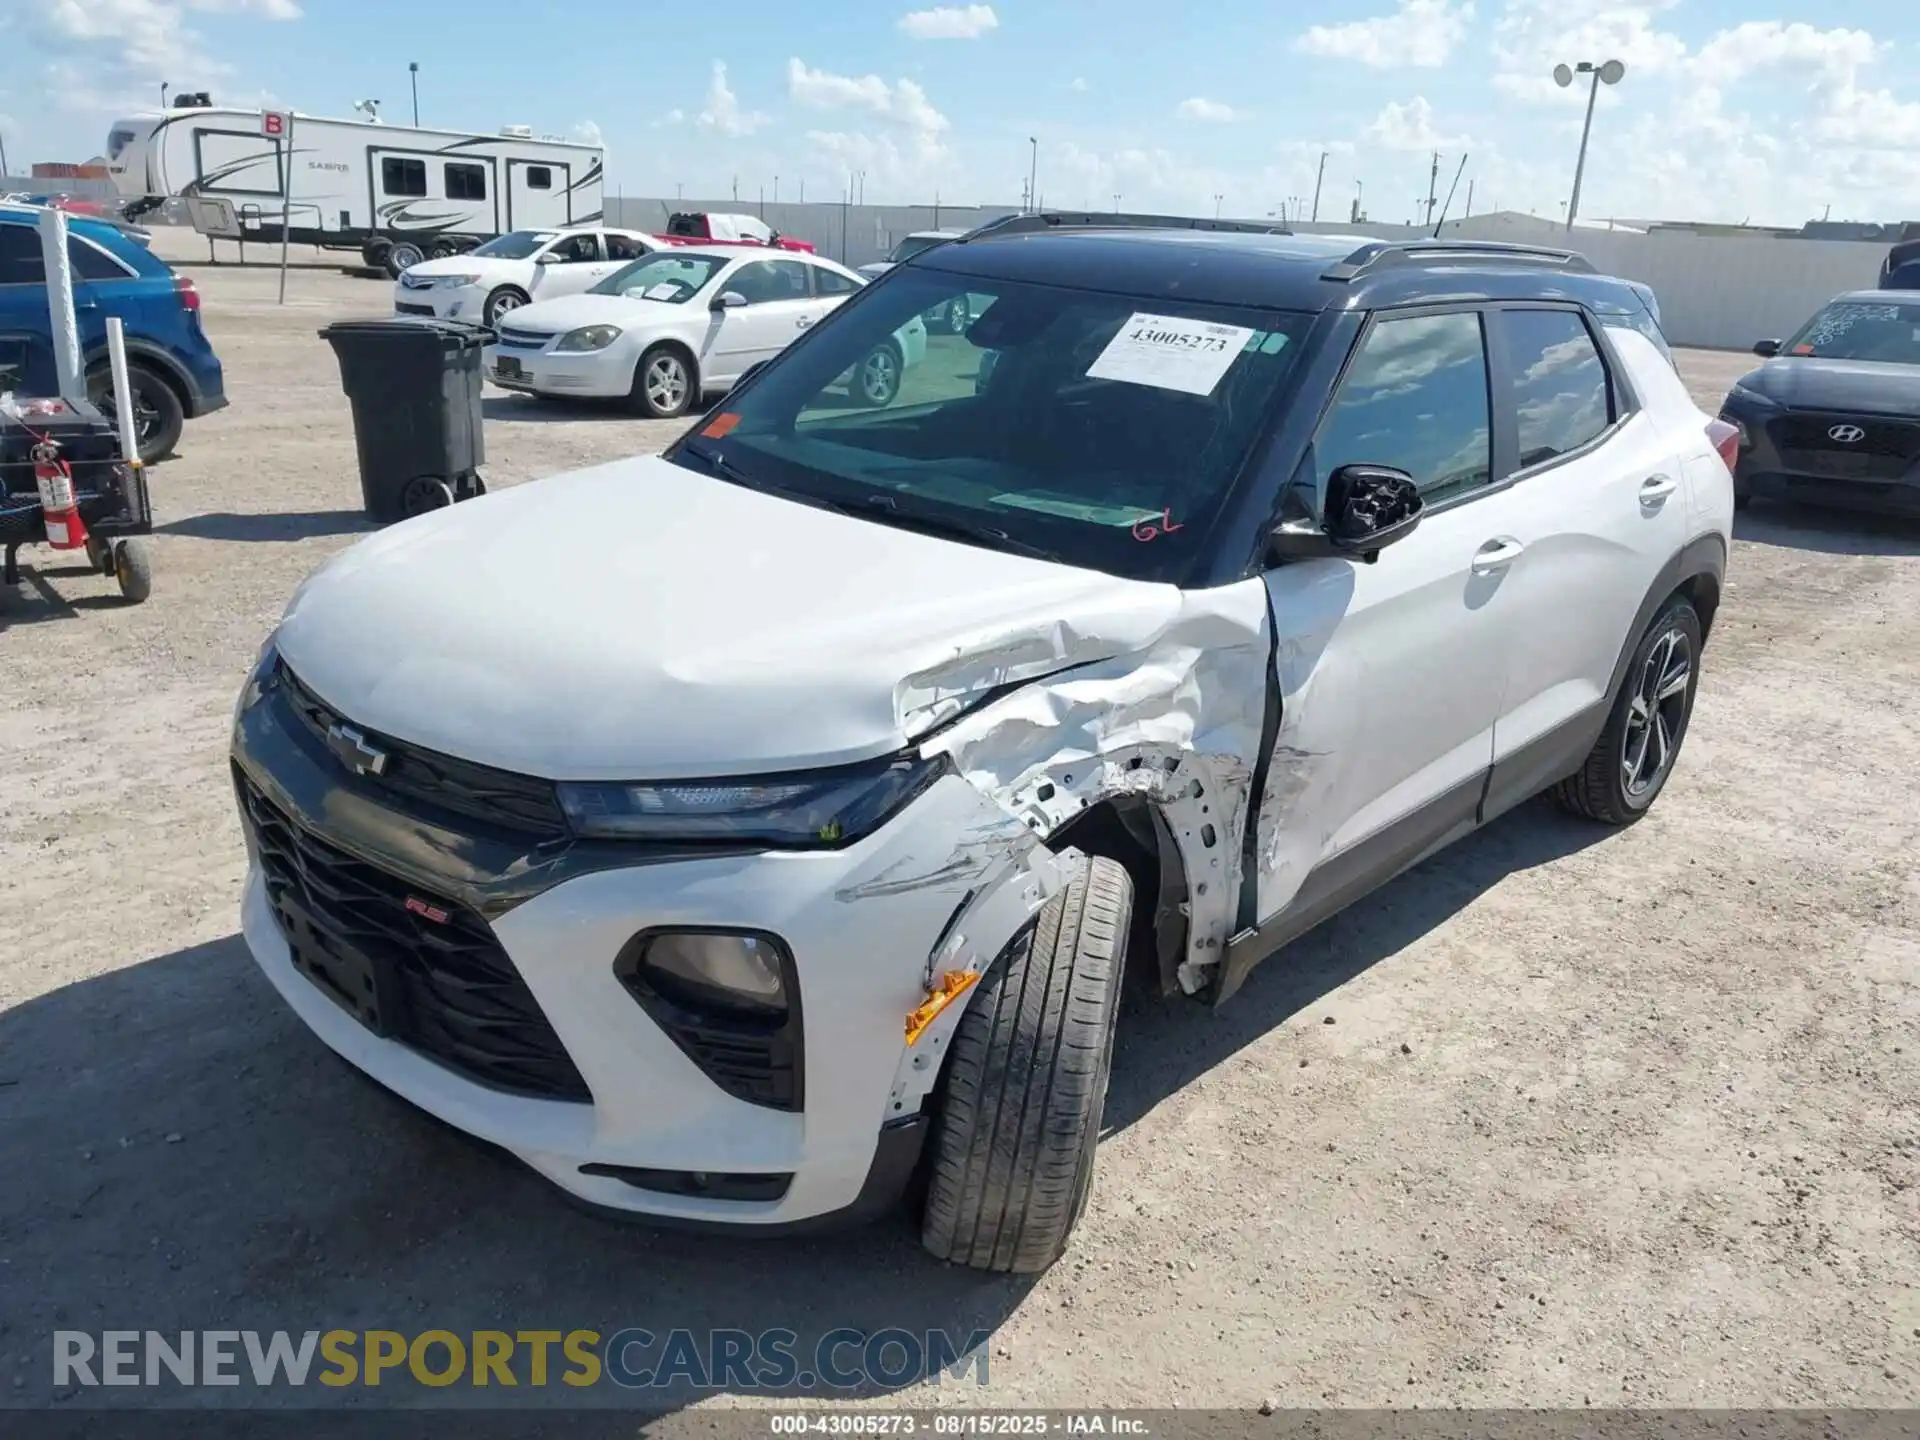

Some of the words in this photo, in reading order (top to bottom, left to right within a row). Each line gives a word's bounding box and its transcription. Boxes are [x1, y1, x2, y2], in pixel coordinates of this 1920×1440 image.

[265, 114, 282, 134] B
[1129, 328, 1227, 352] 43005273
[405, 897, 449, 923] RS
